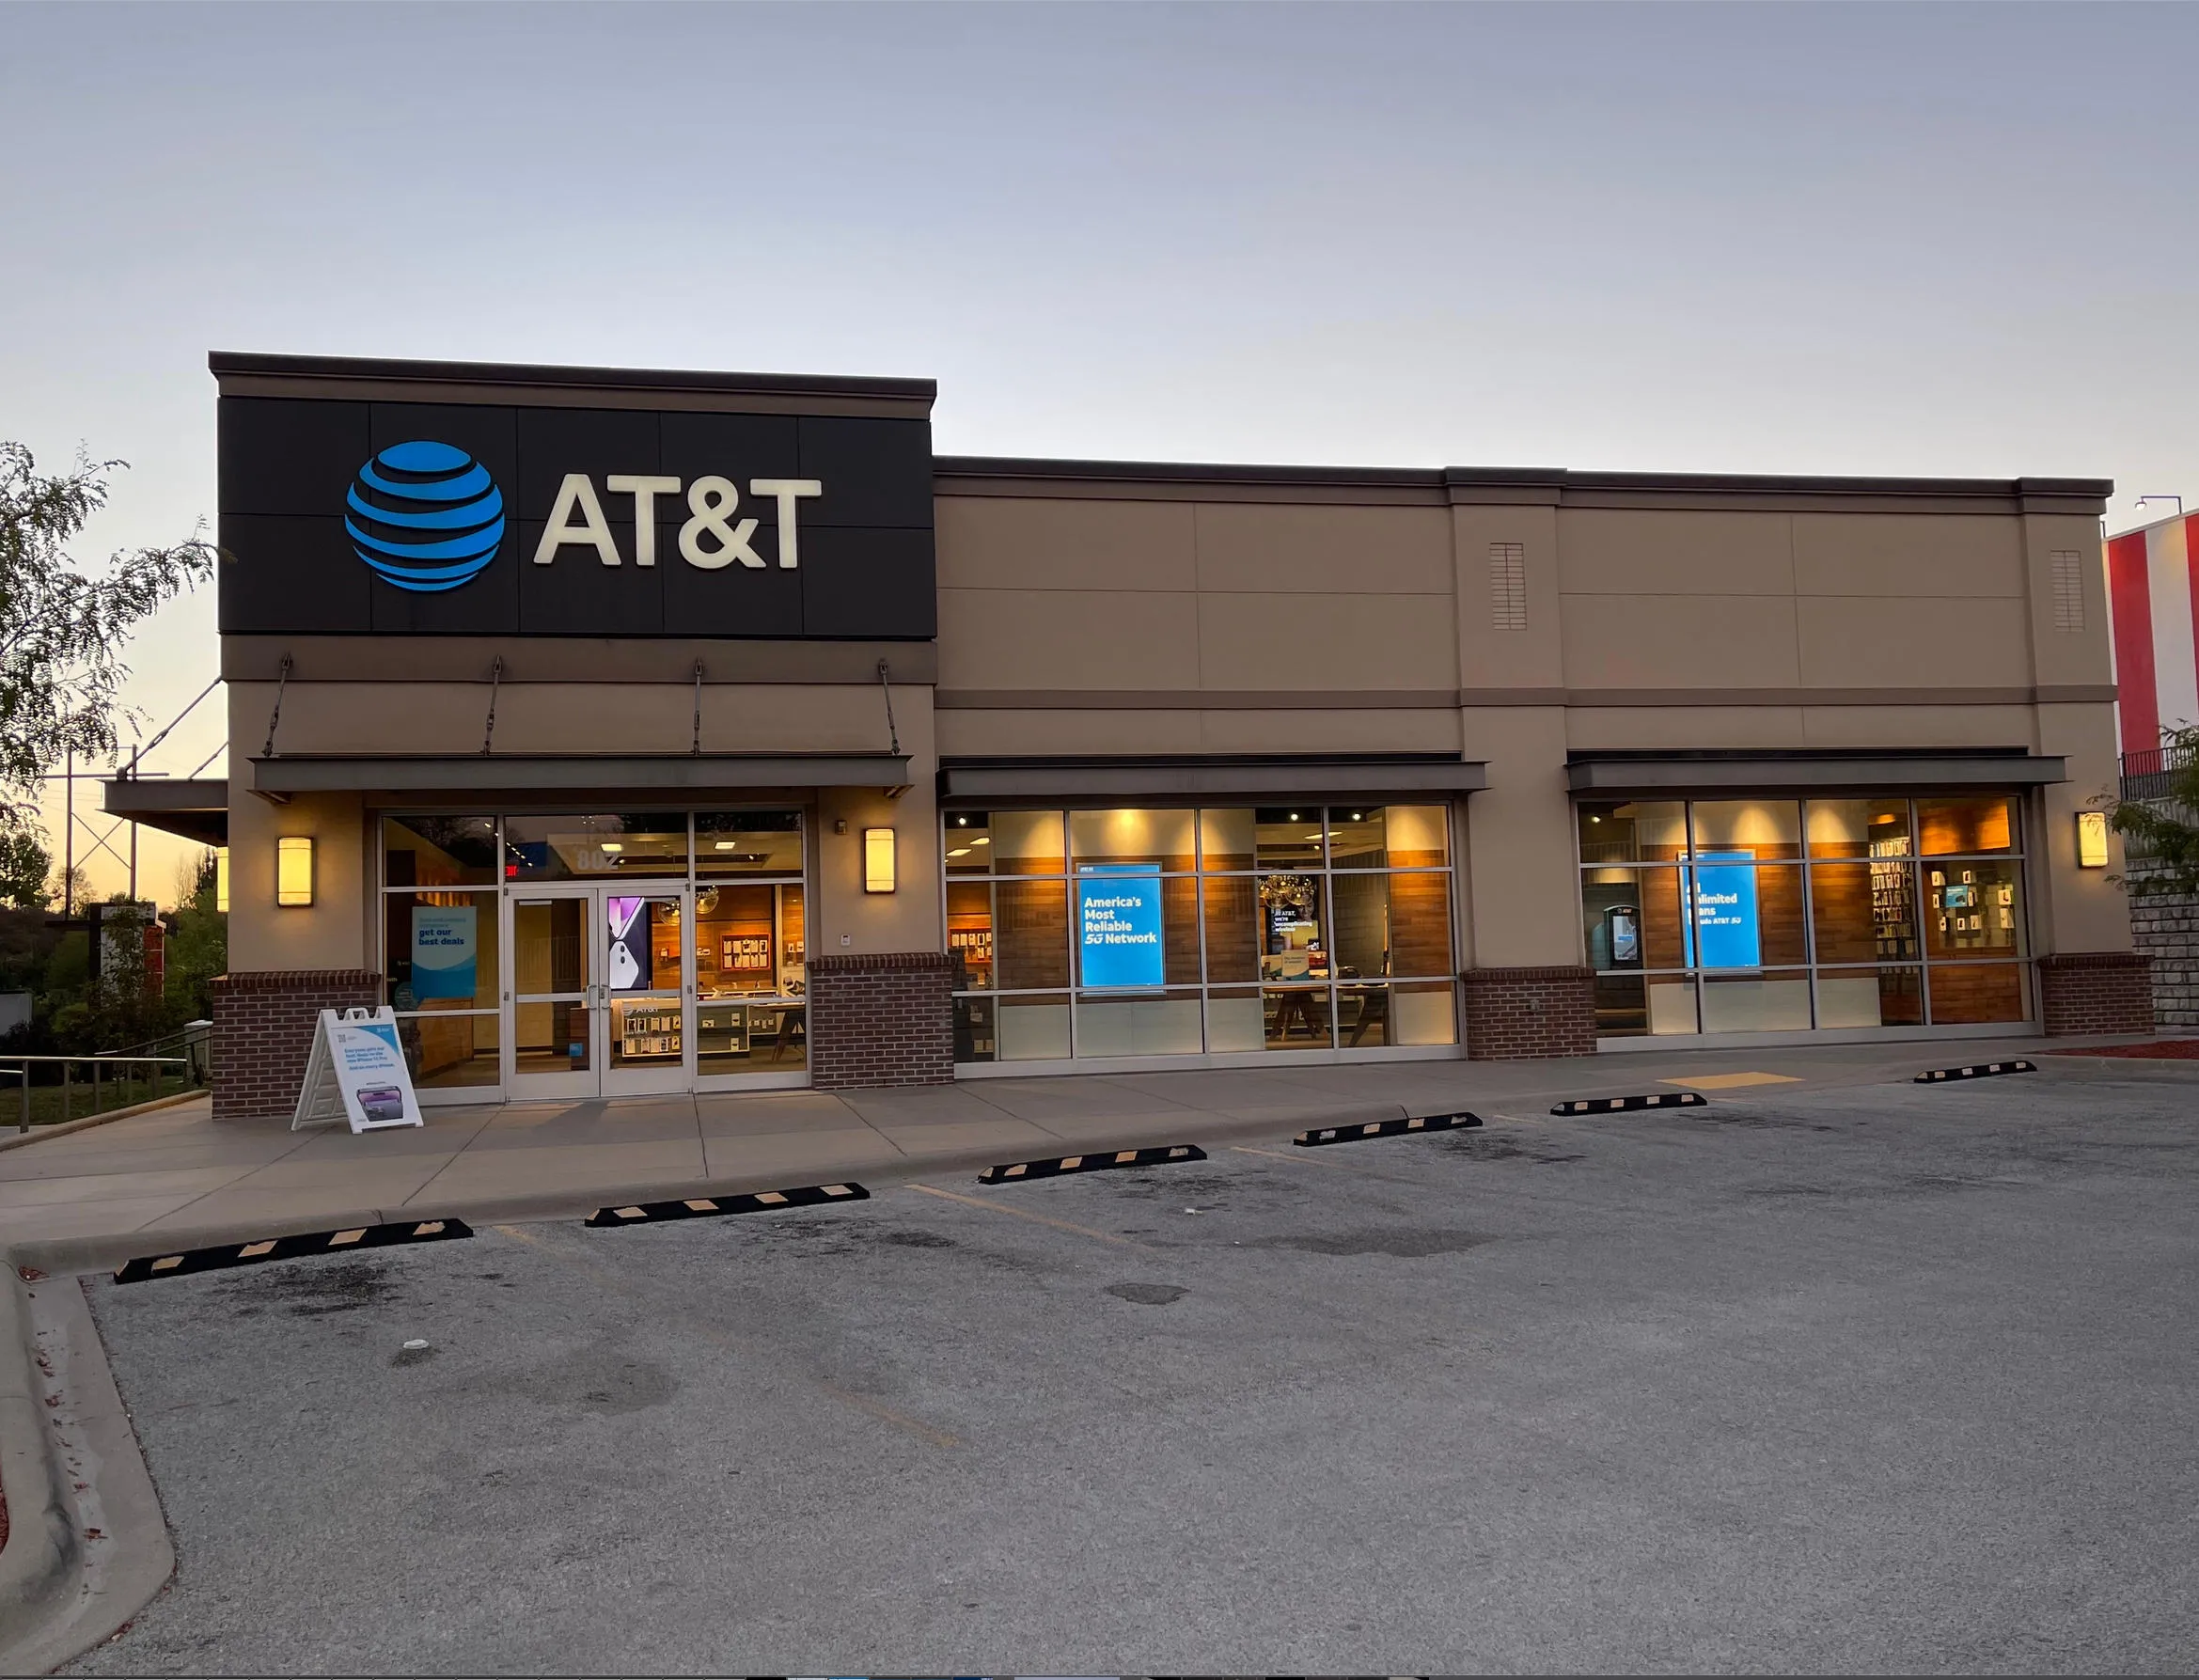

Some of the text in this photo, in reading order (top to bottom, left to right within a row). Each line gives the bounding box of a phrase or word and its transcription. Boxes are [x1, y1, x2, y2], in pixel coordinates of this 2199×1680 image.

[533, 473, 823, 570] AT&T
[576, 850, 620, 871] 802
[1084, 896, 1142, 908] America's
[1084, 909, 1115, 920] Most
[1085, 920, 1133, 933] Reliable
[418, 929, 434, 938] get
[1084, 932, 1157, 945] 5G Network
[440, 937, 465, 946] deals
